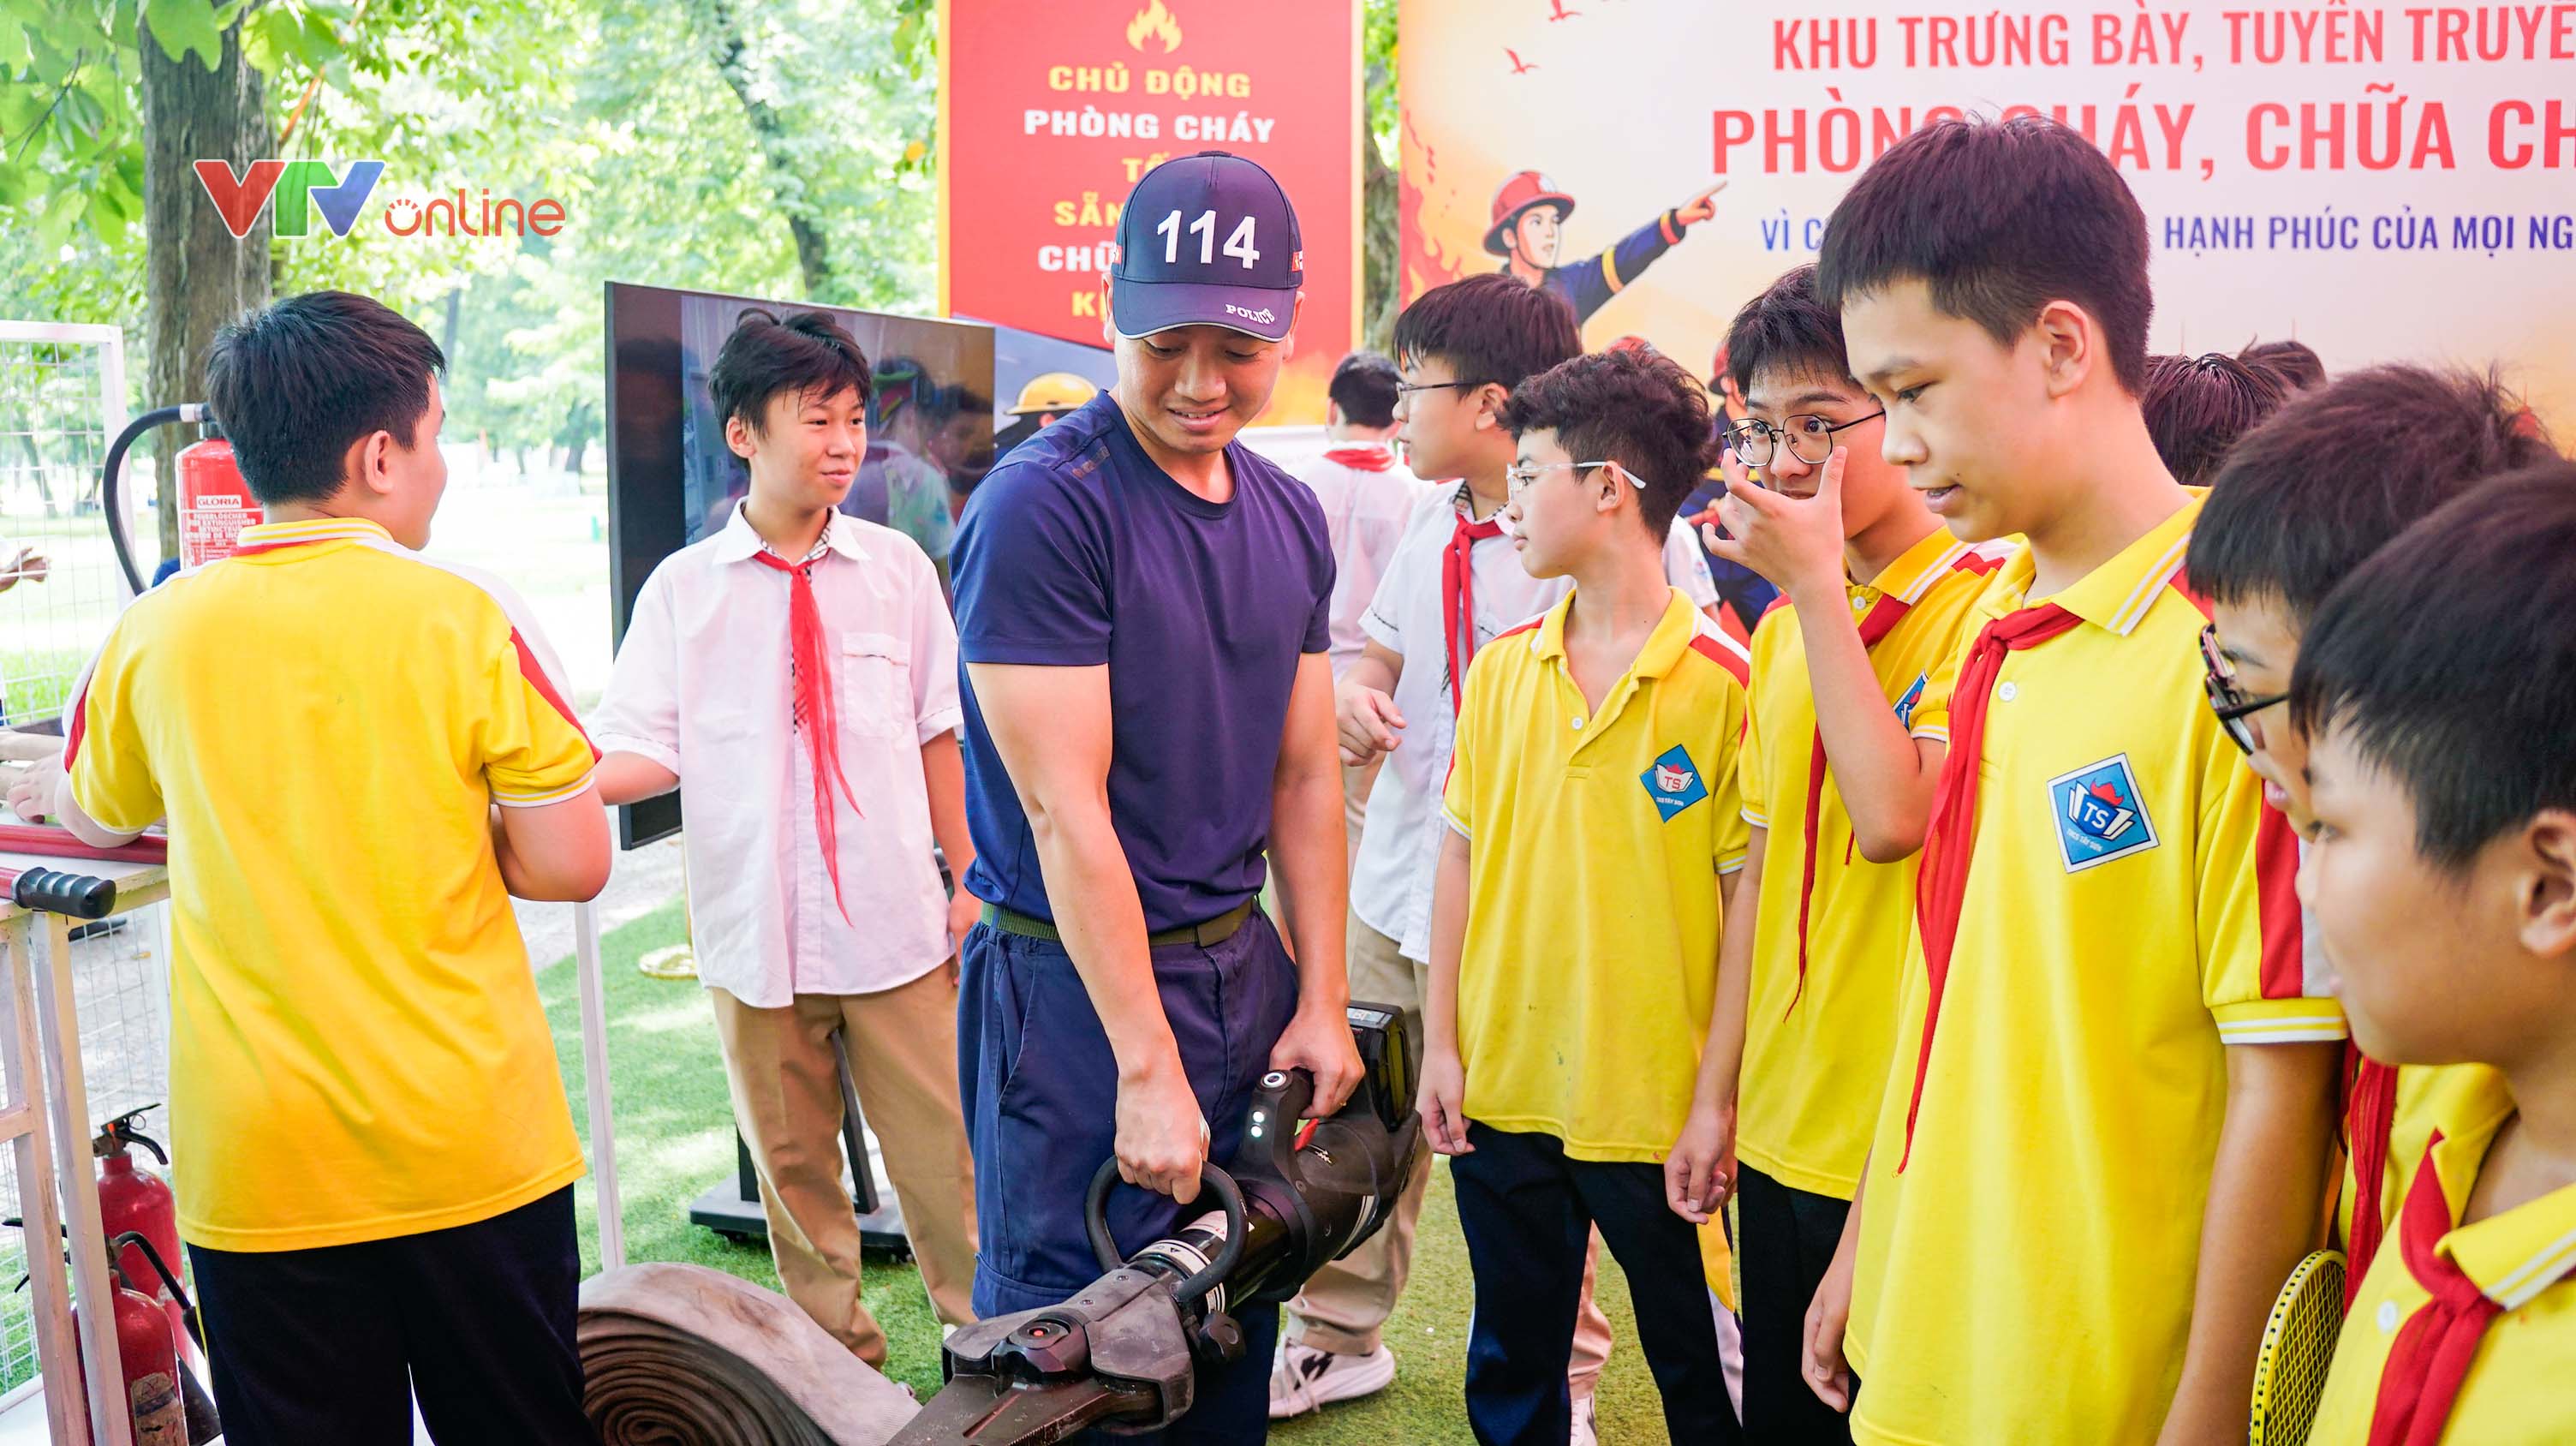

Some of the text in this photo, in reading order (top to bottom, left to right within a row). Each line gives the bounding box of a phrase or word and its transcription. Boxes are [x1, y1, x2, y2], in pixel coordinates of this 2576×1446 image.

[1774, 19, 1878, 70] KHU
[1899, 10, 2069, 68] TRƯNG
[1049, 62, 1251, 101] CHỦ ĐỘNG
[1023, 105, 1276, 143] PHÒNG CHÁY
[2246, 82, 2456, 170] CHỮA
[1157, 210, 1261, 270] 114
[1761, 208, 1790, 250] VÌ
[2164, 216, 2254, 257] HẠNH
[2269, 206, 2359, 250] PHÚC
[2373, 206, 2438, 250] CỦA
[2454, 216, 2514, 257] MỌI
[1225, 303, 1275, 326] POLICE
[198, 498, 240, 506] GLORIA
[1664, 775, 1682, 790] TS
[2083, 802, 2109, 829] TS
